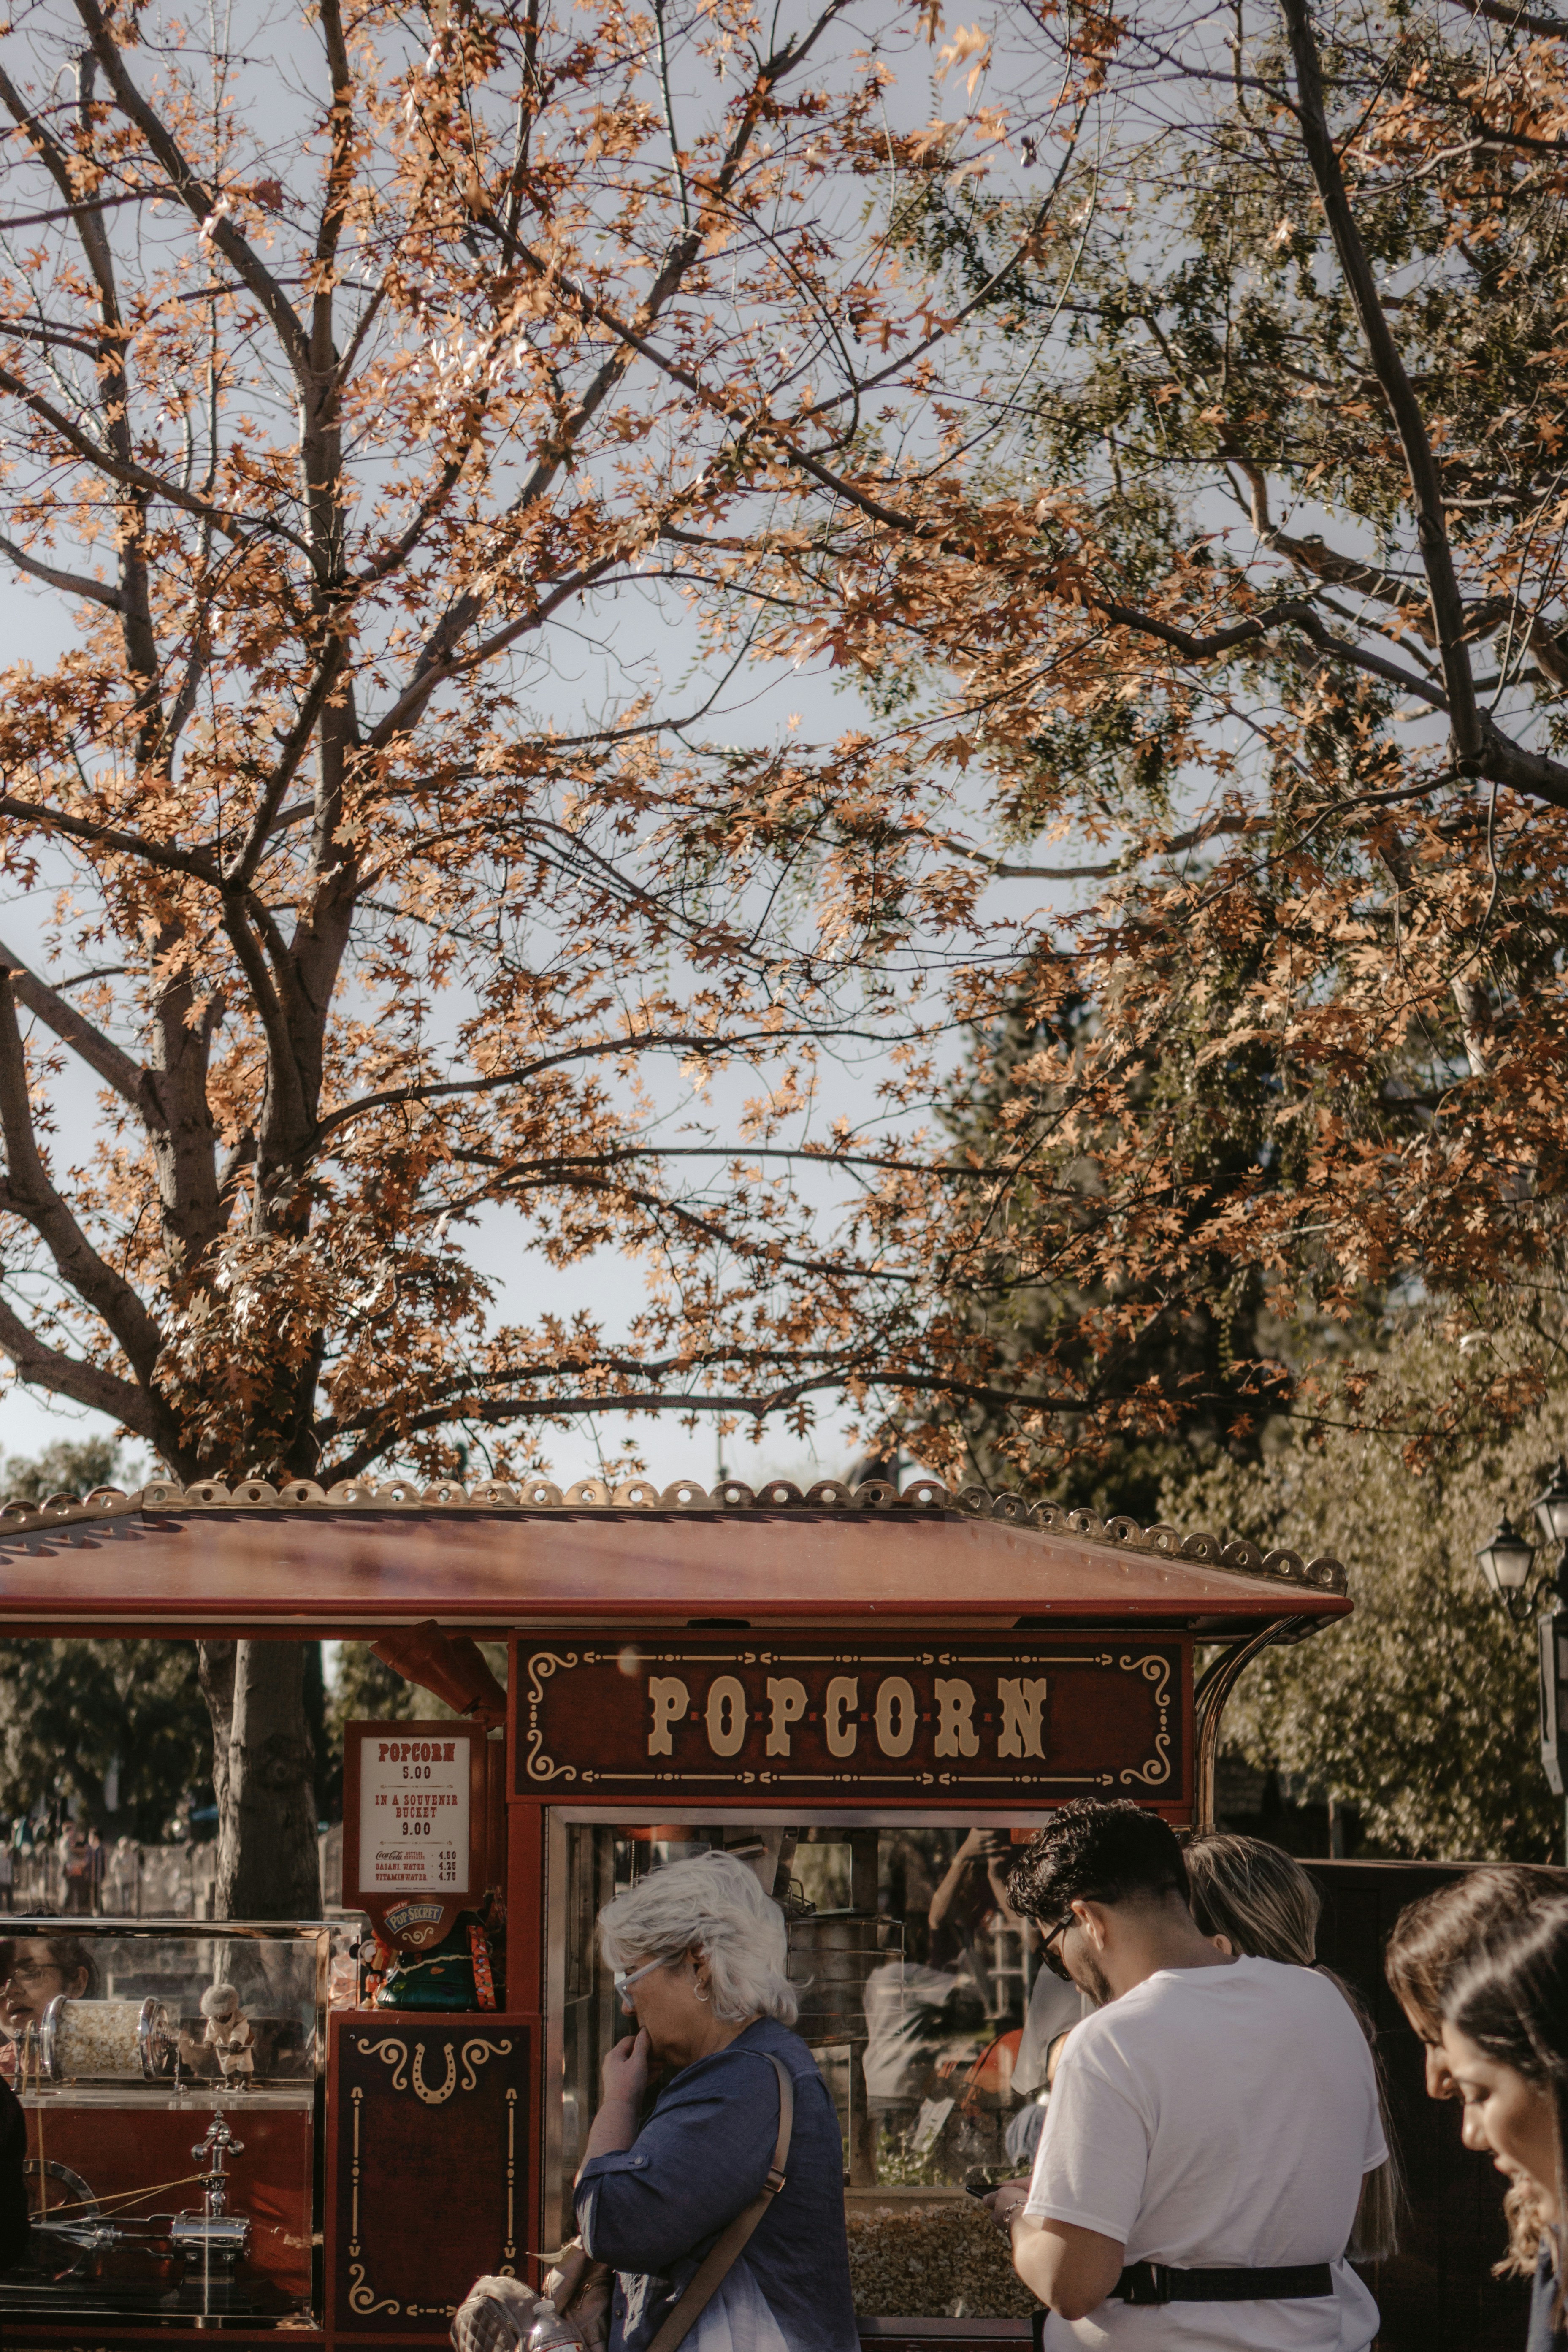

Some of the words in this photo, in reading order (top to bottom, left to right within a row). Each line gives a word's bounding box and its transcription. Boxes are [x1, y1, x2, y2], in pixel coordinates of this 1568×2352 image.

[647, 1676, 1047, 1759] POPCORN
[379, 1743, 455, 1762] POPCORN
[403, 1766, 431, 1779] 5.00
[376, 1795, 387, 1805] IN
[392, 1795, 399, 1805] A
[404, 1795, 458, 1805] SOUVENIR
[396, 1807, 437, 1818] BUCKET
[403, 1822, 430, 1835] 9.00
[439, 1851, 456, 1859] 4.50
[439, 1862, 456, 1870] 4.25
[439, 1872, 456, 1881] 4.75
[386, 1903, 400, 1916] Hosted
